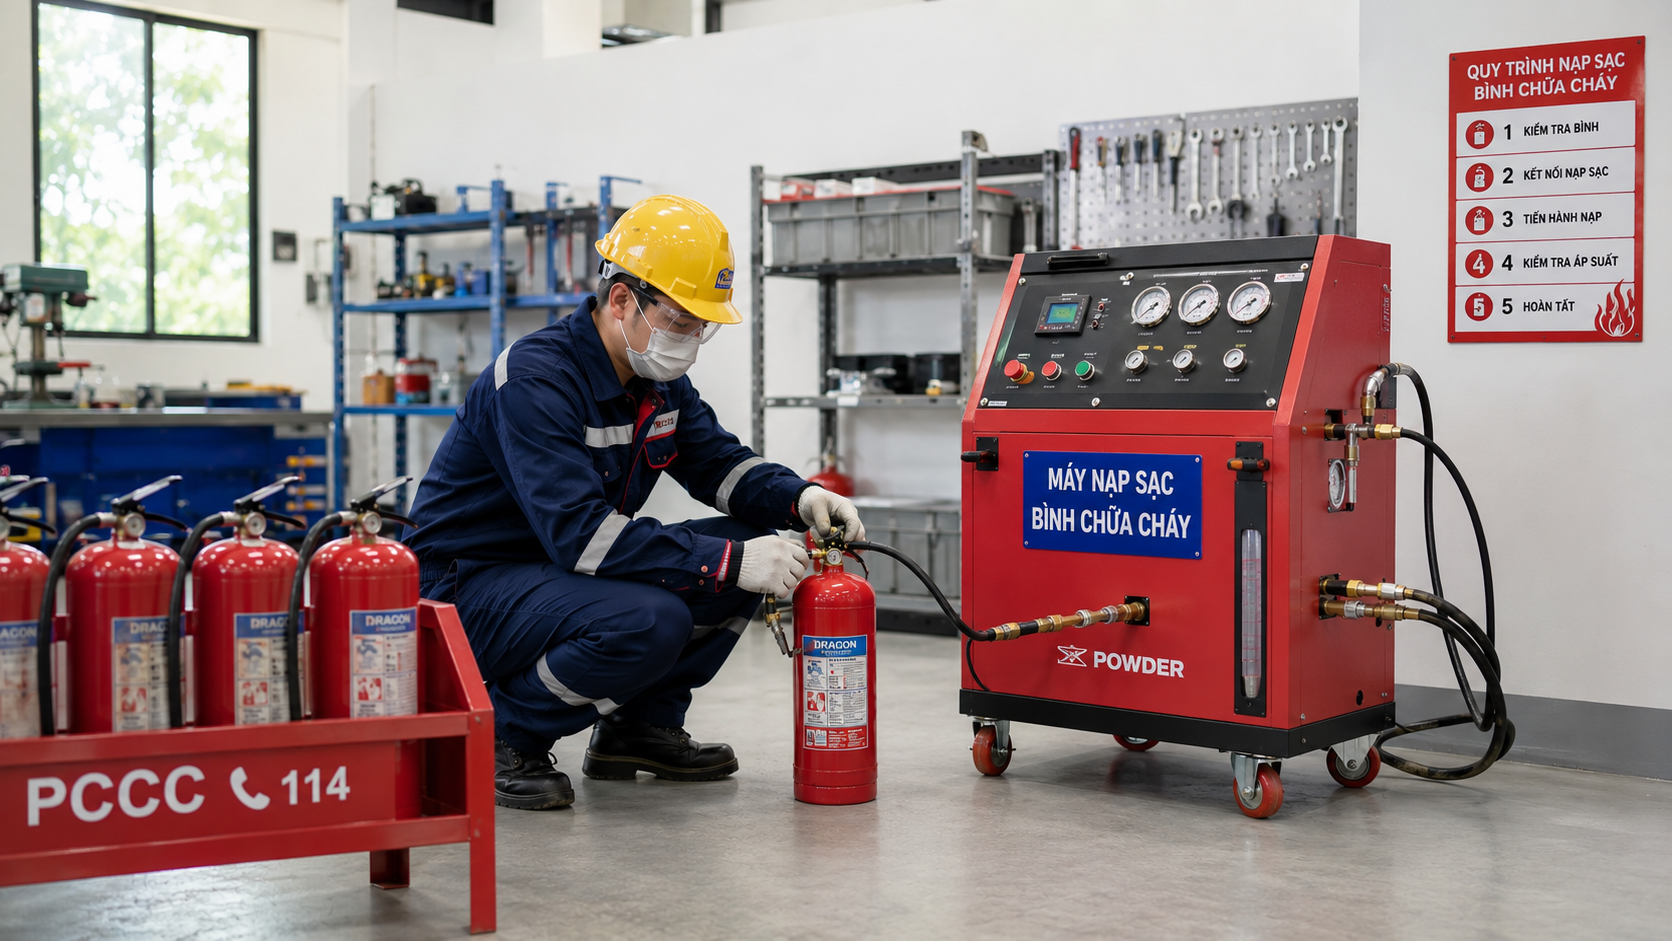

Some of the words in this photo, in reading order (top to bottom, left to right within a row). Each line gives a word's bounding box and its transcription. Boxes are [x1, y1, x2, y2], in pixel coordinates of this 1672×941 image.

[1467, 62, 1501, 81] QUY
[1505, 56, 1554, 76] TRÌNH
[1559, 55, 1591, 75] NẠP
[1594, 52, 1625, 72] SẠC
[1474, 82, 1513, 101] BÌNH
[1518, 76, 1566, 97] CHỮA
[1570, 72, 1618, 93] CHÁY
[1503, 124, 1511, 140] 1
[1551, 123, 1571, 134] TRA
[1574, 120, 1599, 133] BÌNH
[1502, 167, 1514, 184] 2
[1524, 166, 1542, 180] KẾT
[1545, 165, 1562, 179] NỐI
[1565, 167, 1586, 180] NẠP
[1589, 166, 1609, 179] SẠC
[1502, 210, 1514, 227] 3
[1523, 210, 1546, 224] TIẾN
[1548, 210, 1577, 223] HÀNH
[1581, 211, 1602, 224] NẠP
[1501, 254, 1513, 271] 4
[1551, 257, 1571, 268] TRA
[1573, 254, 1588, 267] ÁP
[1590, 252, 1619, 267] SUẤT
[1501, 297, 1513, 315] 5
[1523, 298, 1552, 312] HOÀN
[1555, 298, 1575, 311] TẤT
[1048, 462, 1087, 492] MÁY
[1091, 469, 1130, 498] NẠP
[1135, 470, 1174, 501] SẠC
[1032, 502, 1075, 532] BÌNH
[1080, 505, 1134, 536] CHỮA
[1138, 507, 1192, 539] CHÁY
[1093, 650, 1184, 679] POWDER
[27, 765, 206, 827] PCCC
[280, 765, 351, 806] 114
